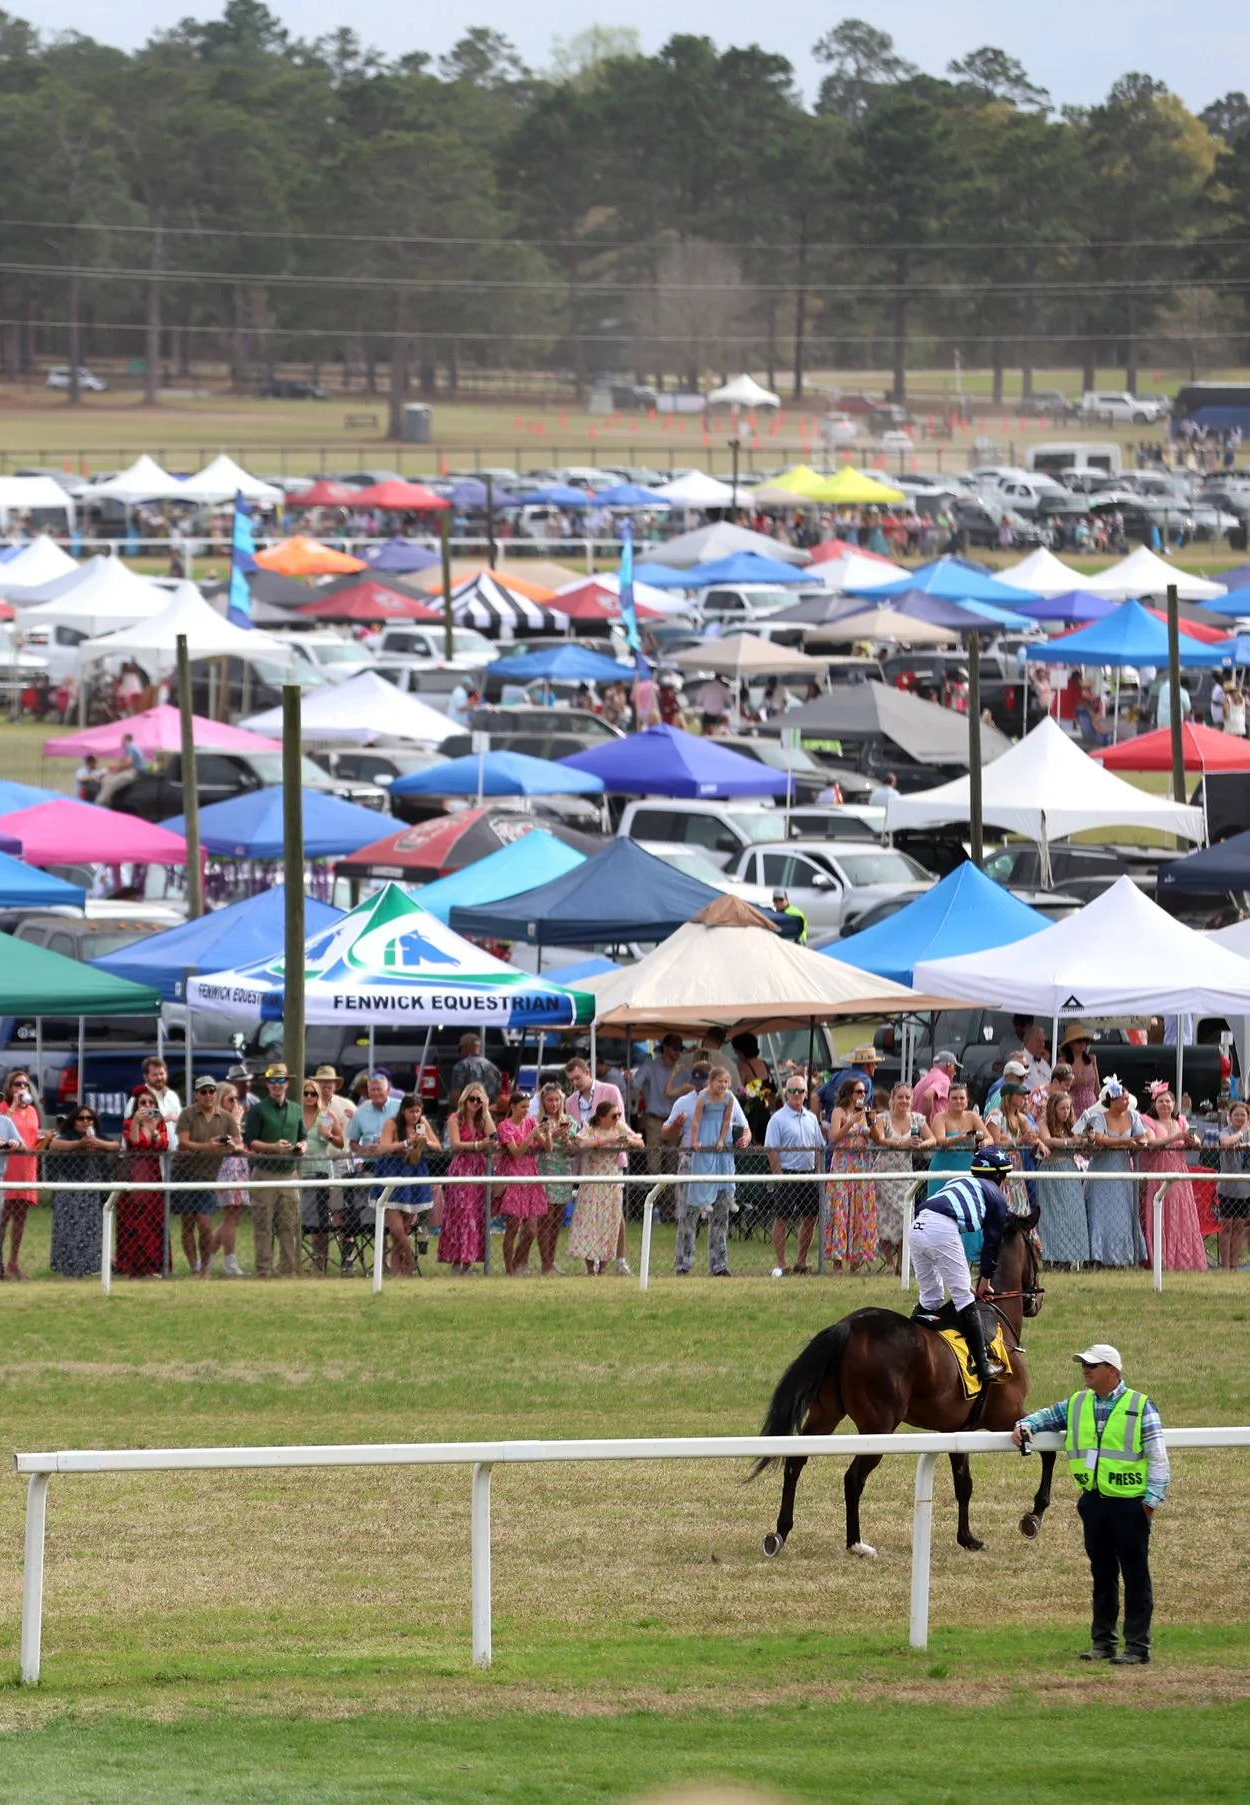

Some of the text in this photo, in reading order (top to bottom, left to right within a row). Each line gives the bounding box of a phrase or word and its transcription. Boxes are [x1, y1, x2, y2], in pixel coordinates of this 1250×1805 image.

[198, 983, 232, 1001] FENWICK
[333, 995, 559, 1011] FENWICK EQUESTRIAN
[1108, 1471, 1143, 1486] PRESS
